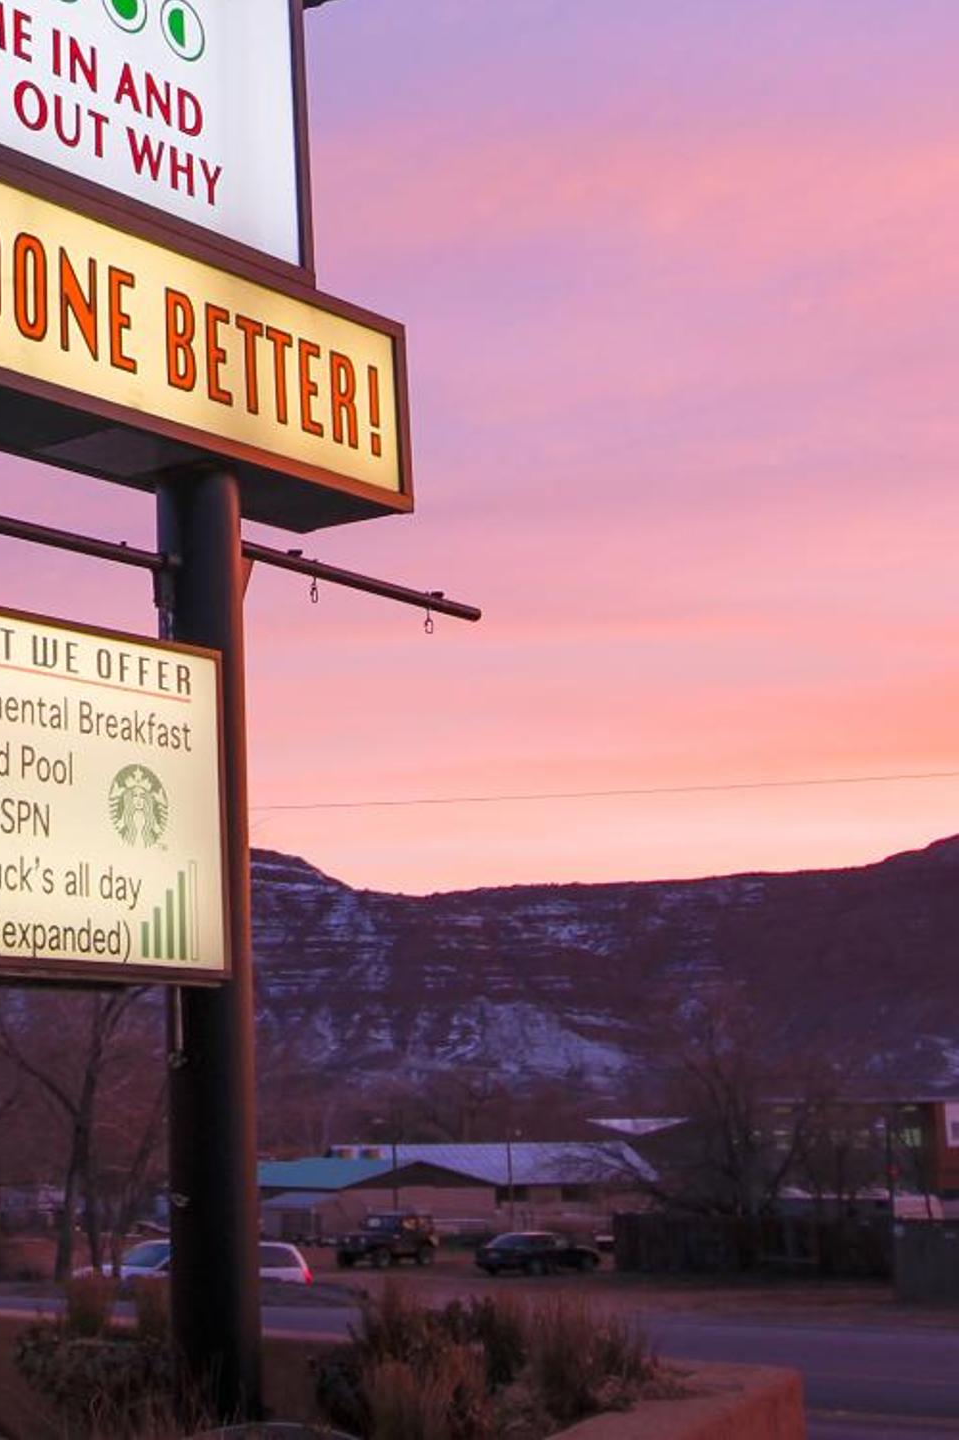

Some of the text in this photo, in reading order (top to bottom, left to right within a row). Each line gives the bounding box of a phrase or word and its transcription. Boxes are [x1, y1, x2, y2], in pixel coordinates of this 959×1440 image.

[52, 29, 98, 93] IN
[115, 63, 204, 138] AND
[13, 80, 110, 159] OUT
[126, 125, 223, 207] WHY
[164, 286, 383, 458] BETTER!
[31, 633, 79, 674] WE
[96, 647, 192, 696] OFFER
[79, 700, 192, 752] Breakfast
[20, 746, 74, 786] Pool
[64, 862, 90, 898] all
[100, 866, 142, 910] day
